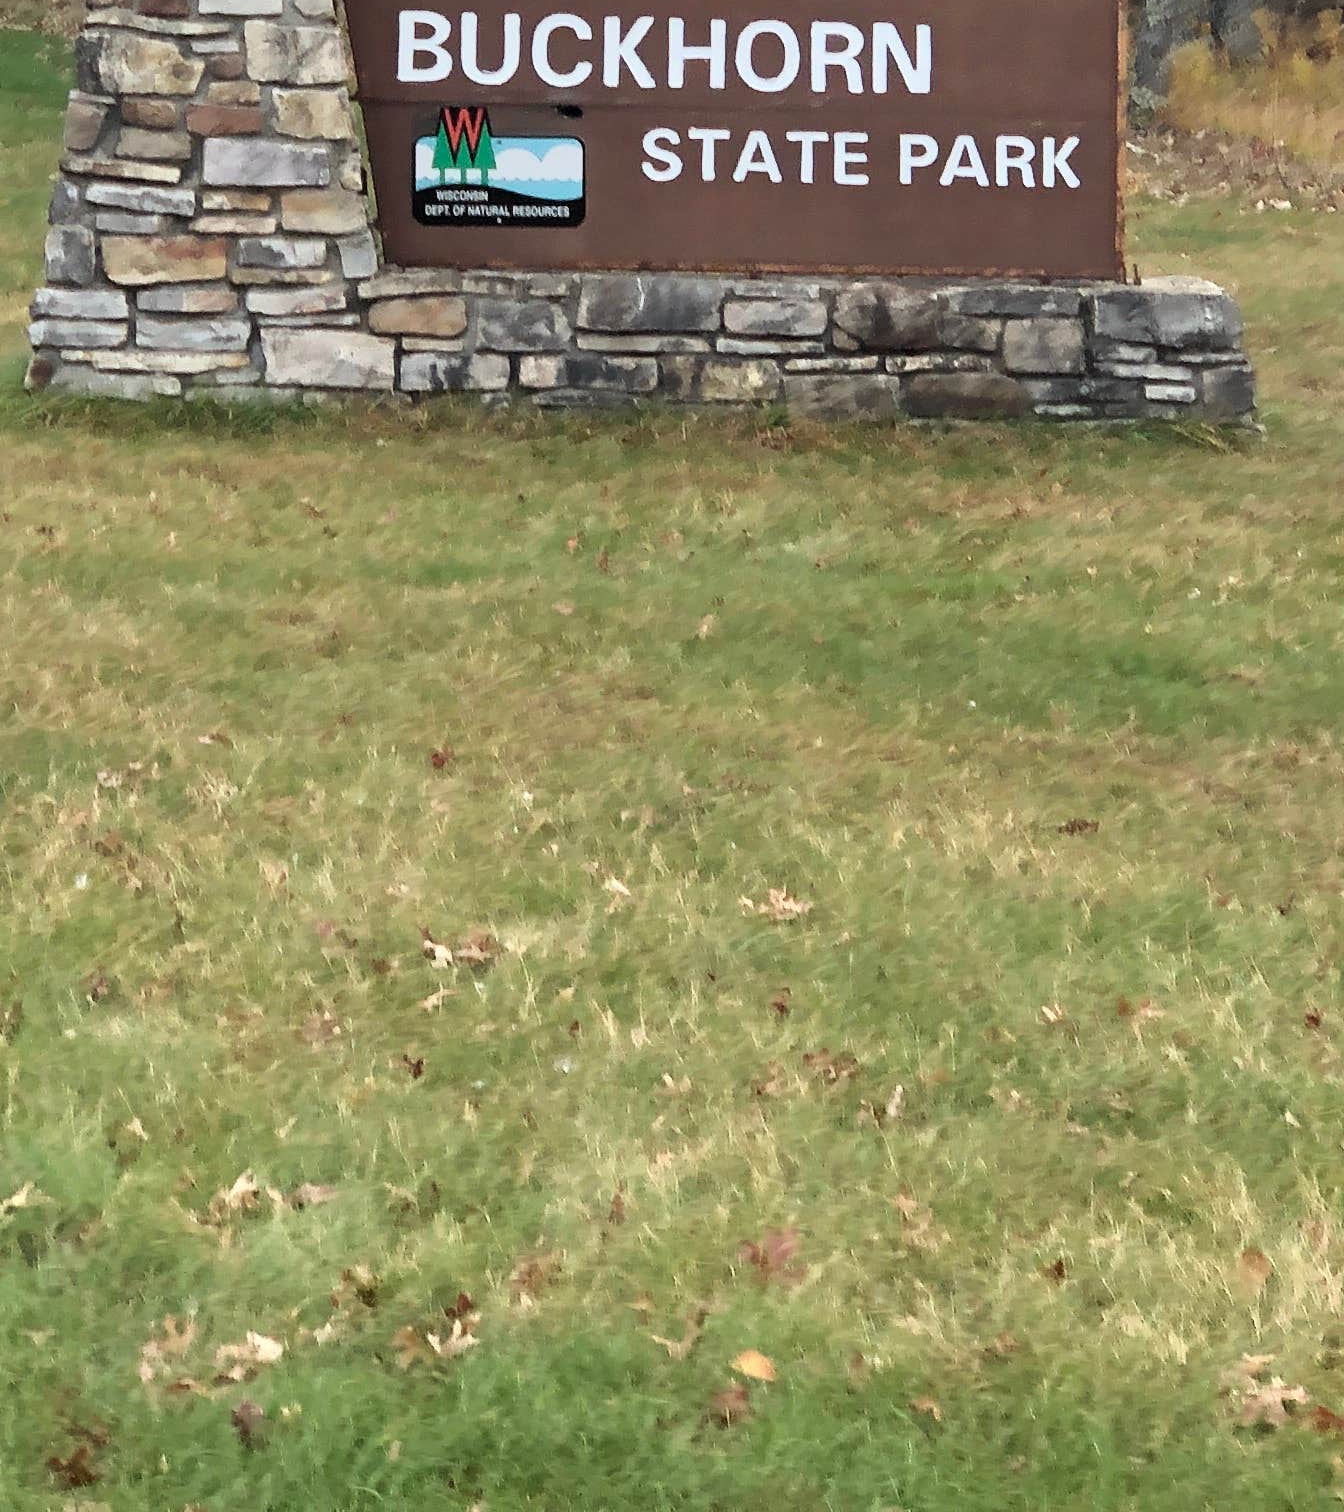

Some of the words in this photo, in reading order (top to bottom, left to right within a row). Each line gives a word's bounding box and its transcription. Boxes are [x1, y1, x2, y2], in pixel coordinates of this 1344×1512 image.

[396, 9, 933, 95] BUCKHORN
[641, 126, 870, 186] STATE
[898, 133, 1082, 190] PARK
[424, 203, 451, 217] DEPT.
[452, 204, 466, 217] OF
[467, 204, 511, 218] NATURAL
[512, 205, 571, 218] RESOURCES
[435, 189, 489, 202] WISCONSIN
